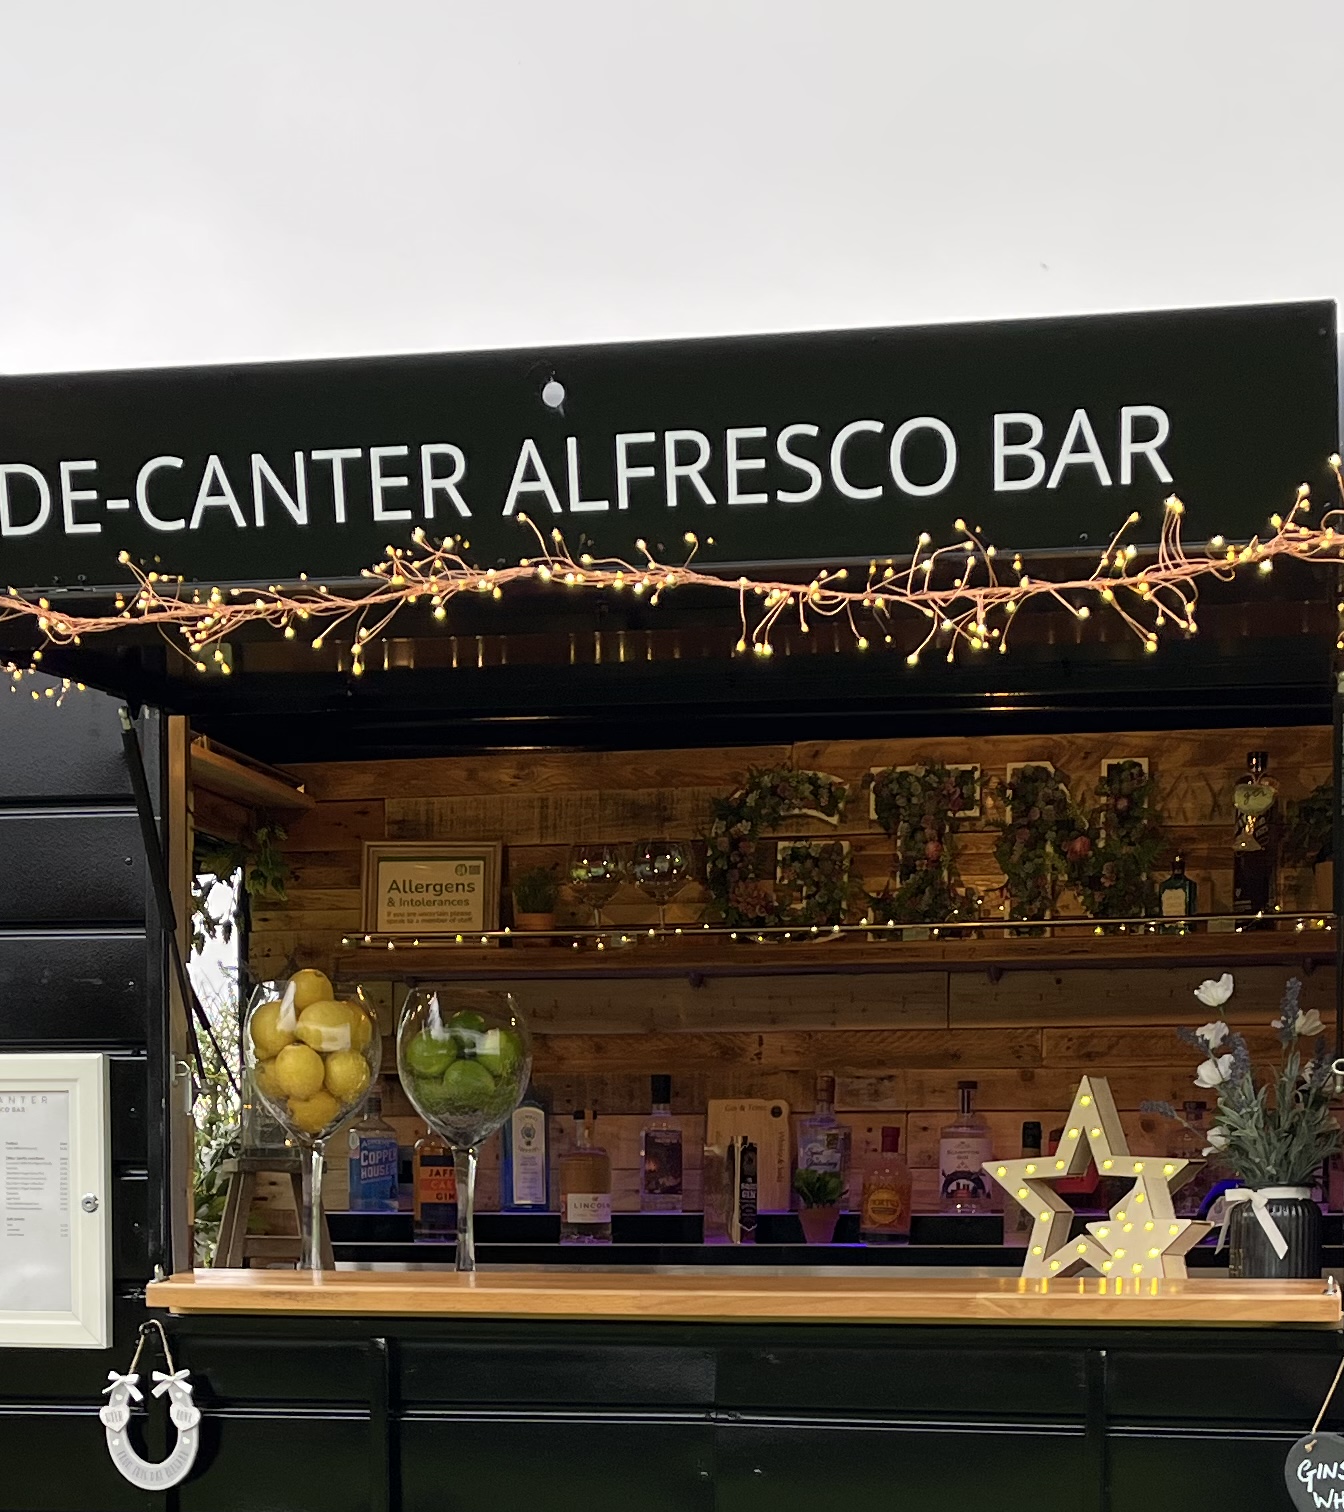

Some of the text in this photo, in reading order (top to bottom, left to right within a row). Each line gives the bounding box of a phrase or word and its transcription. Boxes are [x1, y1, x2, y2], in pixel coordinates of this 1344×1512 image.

[503, 414, 958, 519] ALFRESCO
[993, 403, 1175, 494] BAR
[387, 879, 476, 897] Allergens
[386, 897, 470, 907] & Intolerances
[361, 1163, 390, 1180] HOUSE
